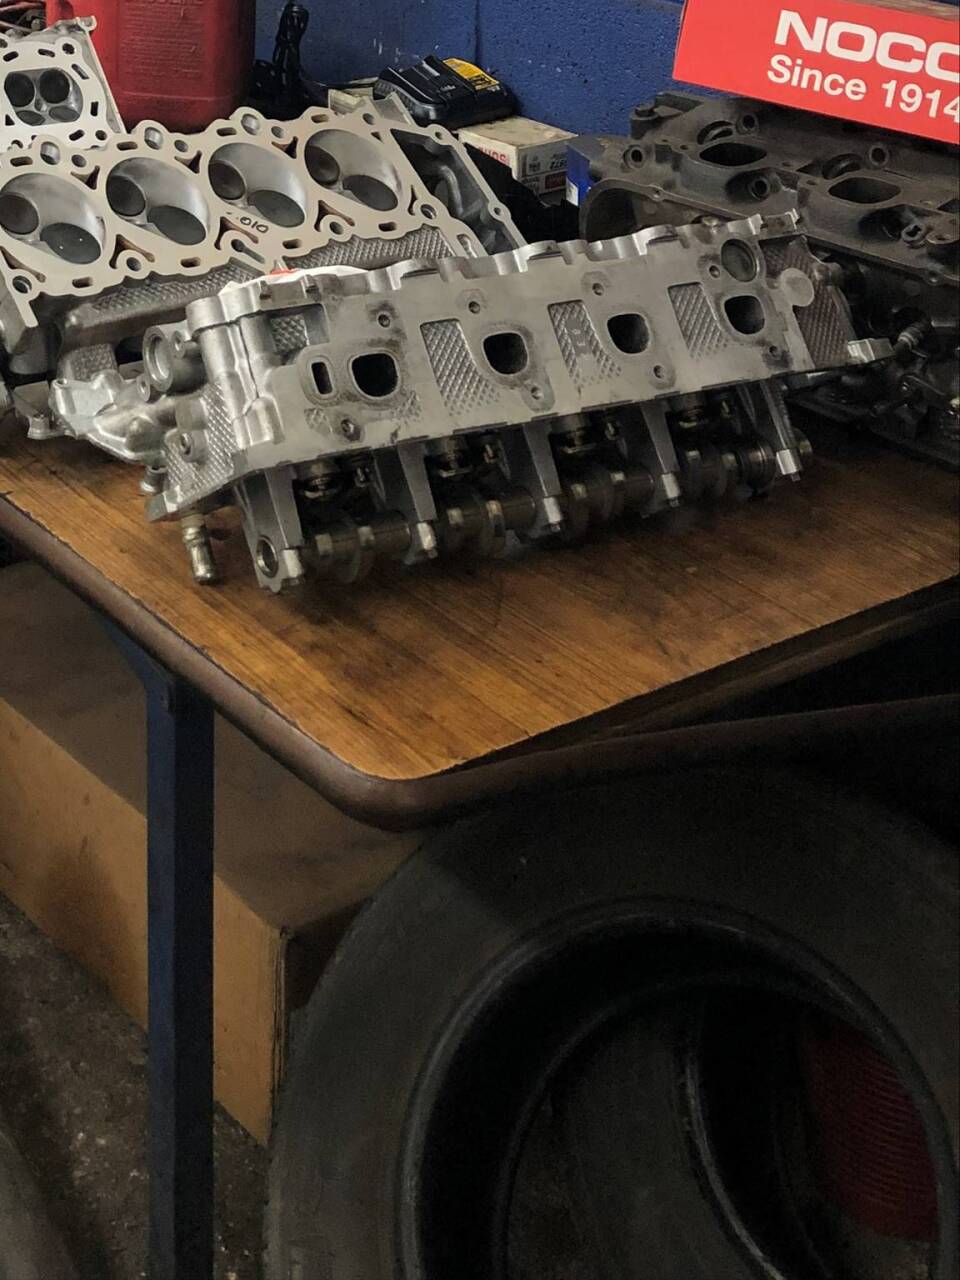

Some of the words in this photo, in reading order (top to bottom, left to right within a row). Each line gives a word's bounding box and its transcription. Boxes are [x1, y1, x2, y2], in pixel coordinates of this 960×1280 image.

[774, 9, 960, 84] NOCO
[767, 54, 867, 100] Since
[881, 80, 960, 124] 1914
